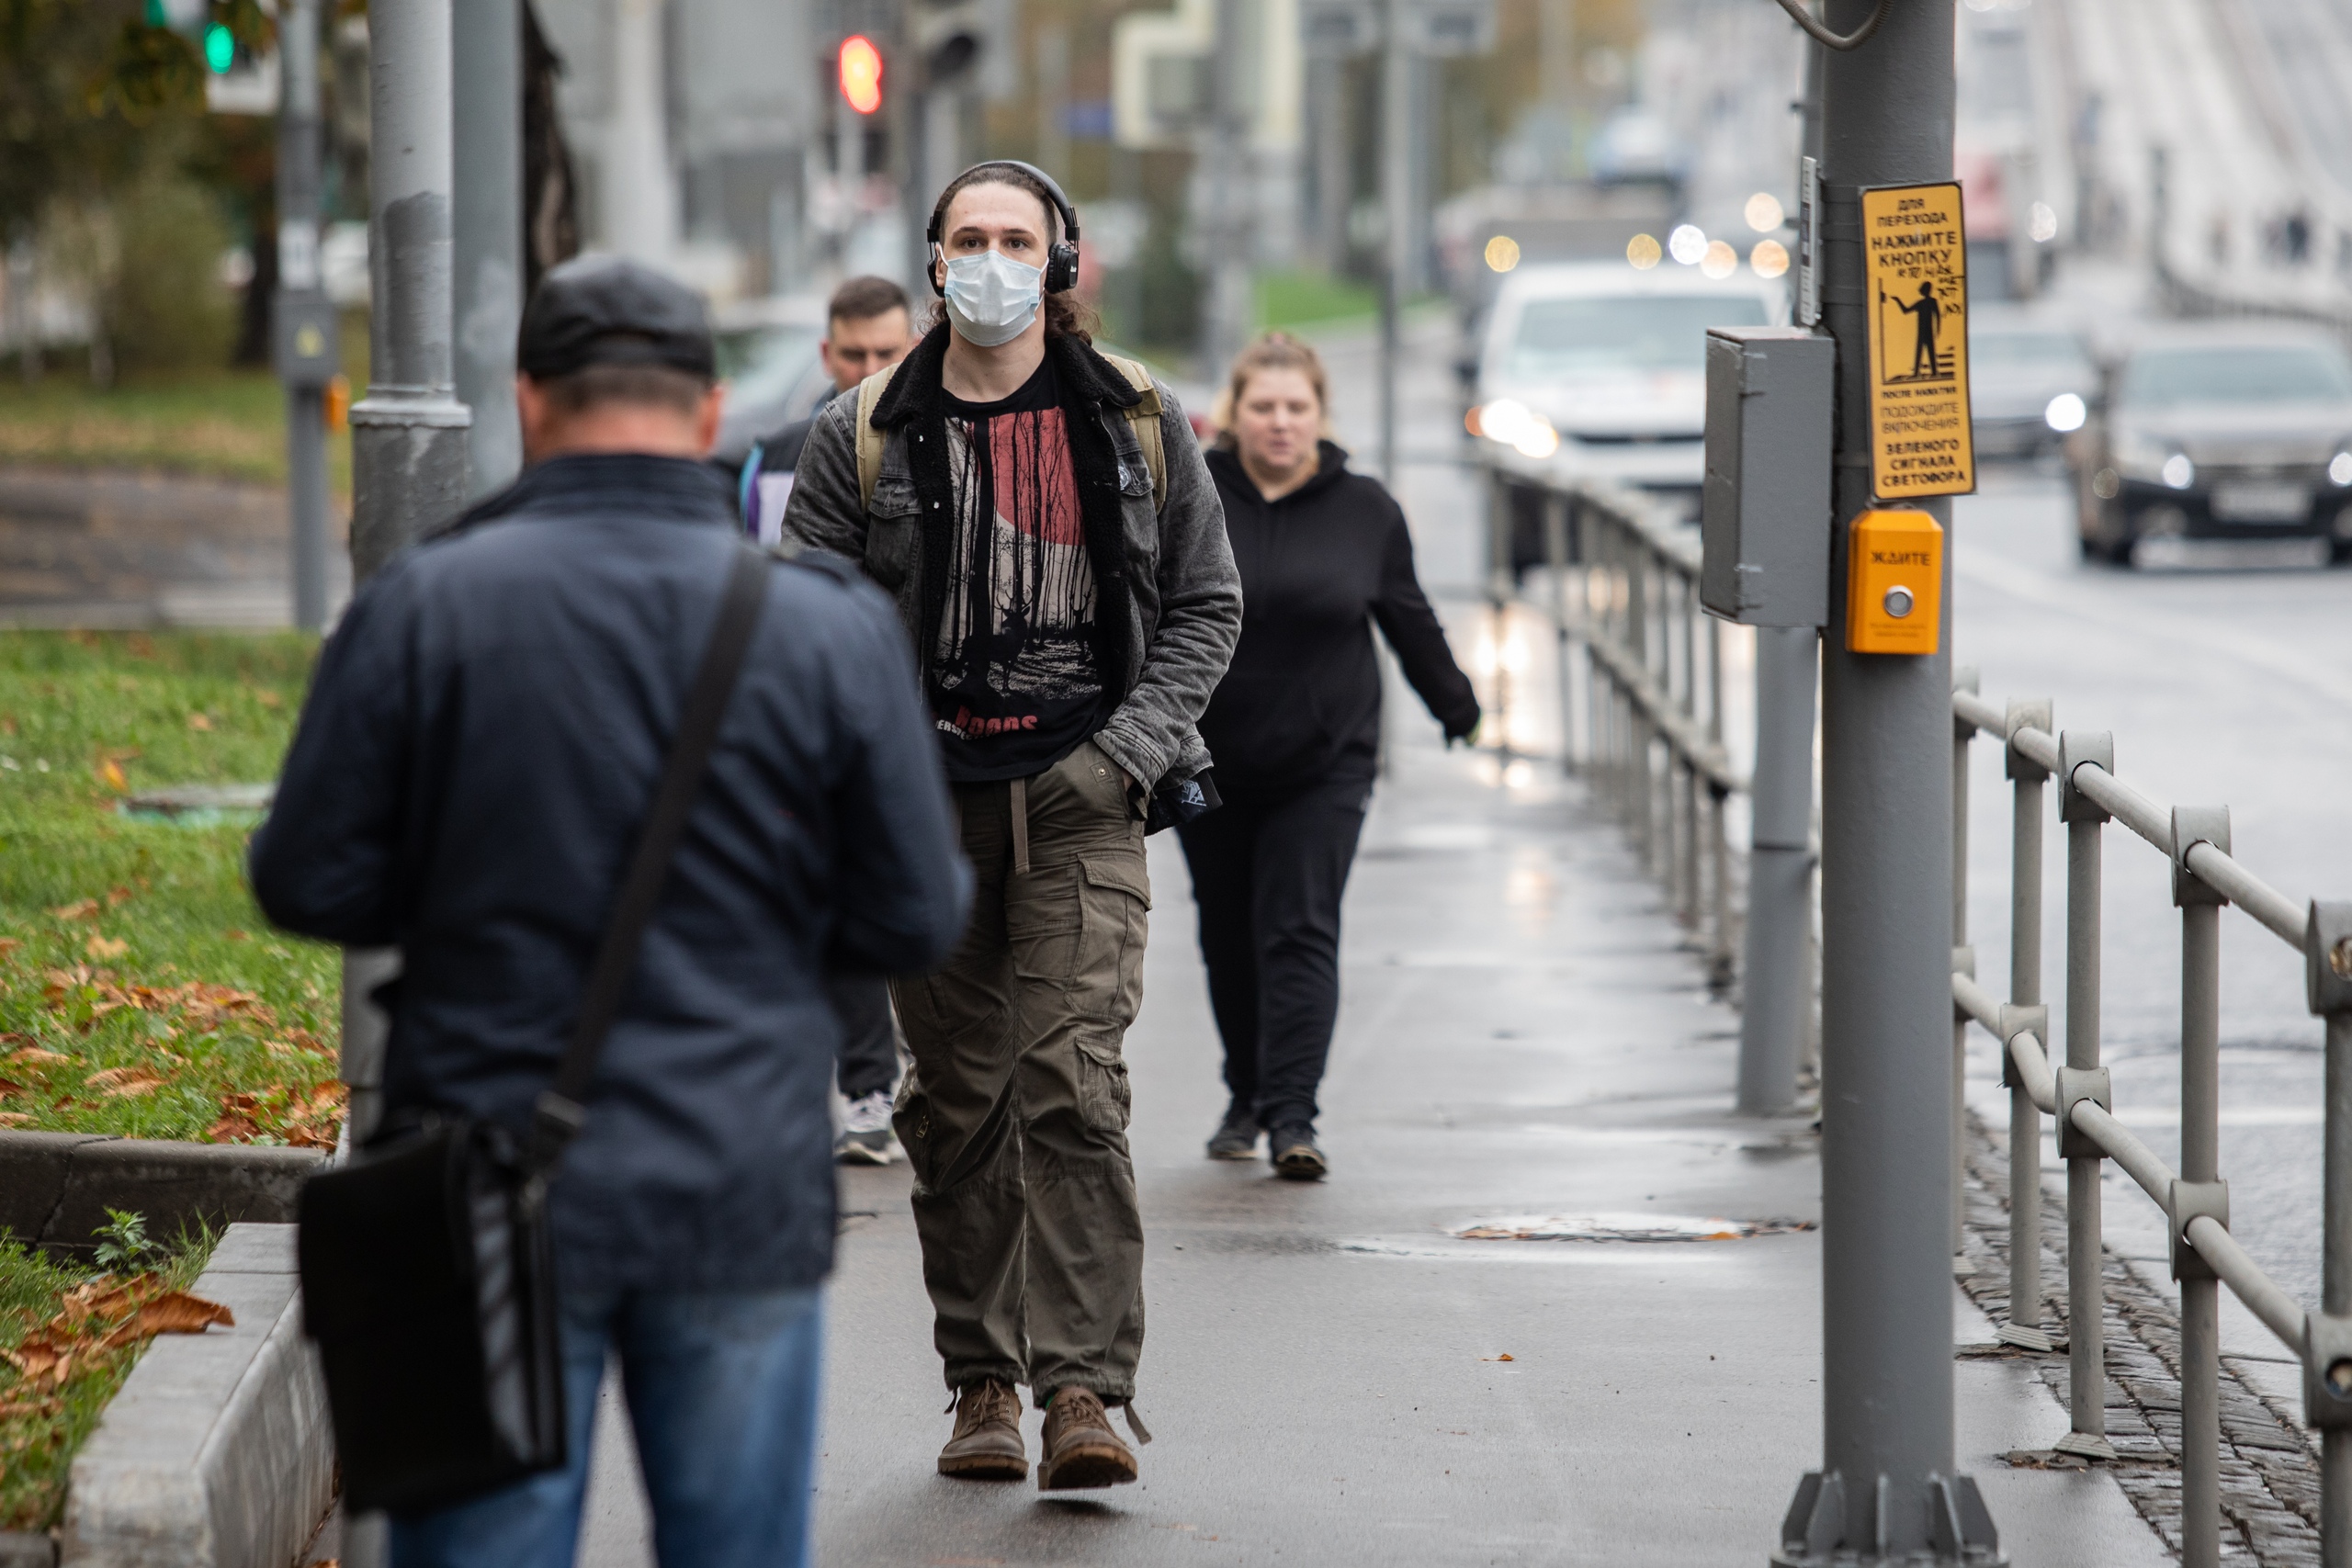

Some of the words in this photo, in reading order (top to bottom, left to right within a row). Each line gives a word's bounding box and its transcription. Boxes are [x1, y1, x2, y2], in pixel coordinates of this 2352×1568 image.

[1898, 199, 1925, 211] ДЛЯ
[1877, 212, 1949, 227] ПЕРЕХОДА
[1871, 231, 1957, 250] НАЖМИТЕ
[1880, 250, 1951, 266] КНОПКУ
[1883, 389, 1911, 399] ПОСЛЕ
[1882, 403, 1959, 419] ПОДОЖДИТЕ
[1883, 419, 1959, 434] ВКЛЮЧЕНИЯ
[1887, 439, 1960, 455] ЗЕЛЕНОГО
[1891, 456, 1955, 470] СИГНАЛА
[1883, 471, 1964, 487] СВЕТОФОРА
[1871, 552, 1930, 566] ЖДИТЕ
